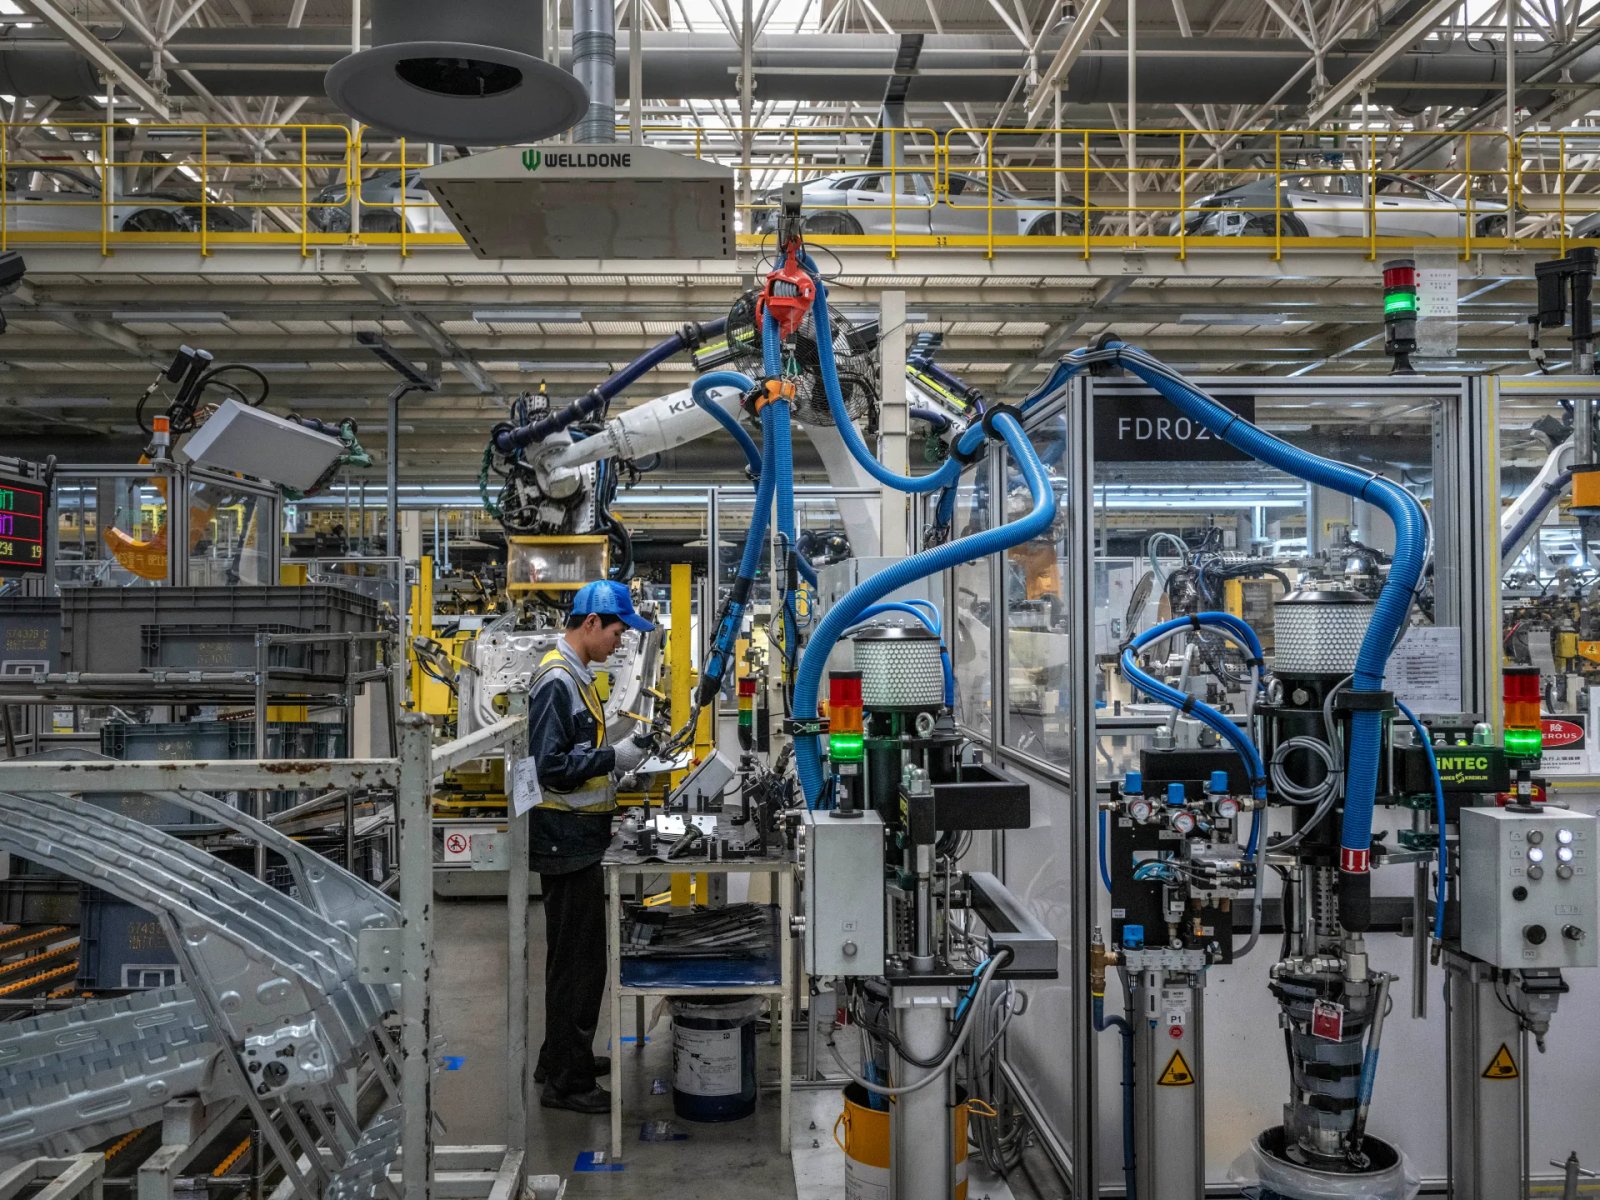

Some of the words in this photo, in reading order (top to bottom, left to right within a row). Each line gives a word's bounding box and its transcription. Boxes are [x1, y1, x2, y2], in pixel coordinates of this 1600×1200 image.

[544, 153, 631, 167] WELLDONE
[669, 389, 722, 414] KUA
[1118, 417, 1225, 440] FDR02
[1549, 723, 1563, 732] 险
[1171, 1015, 1182, 1024] P1
